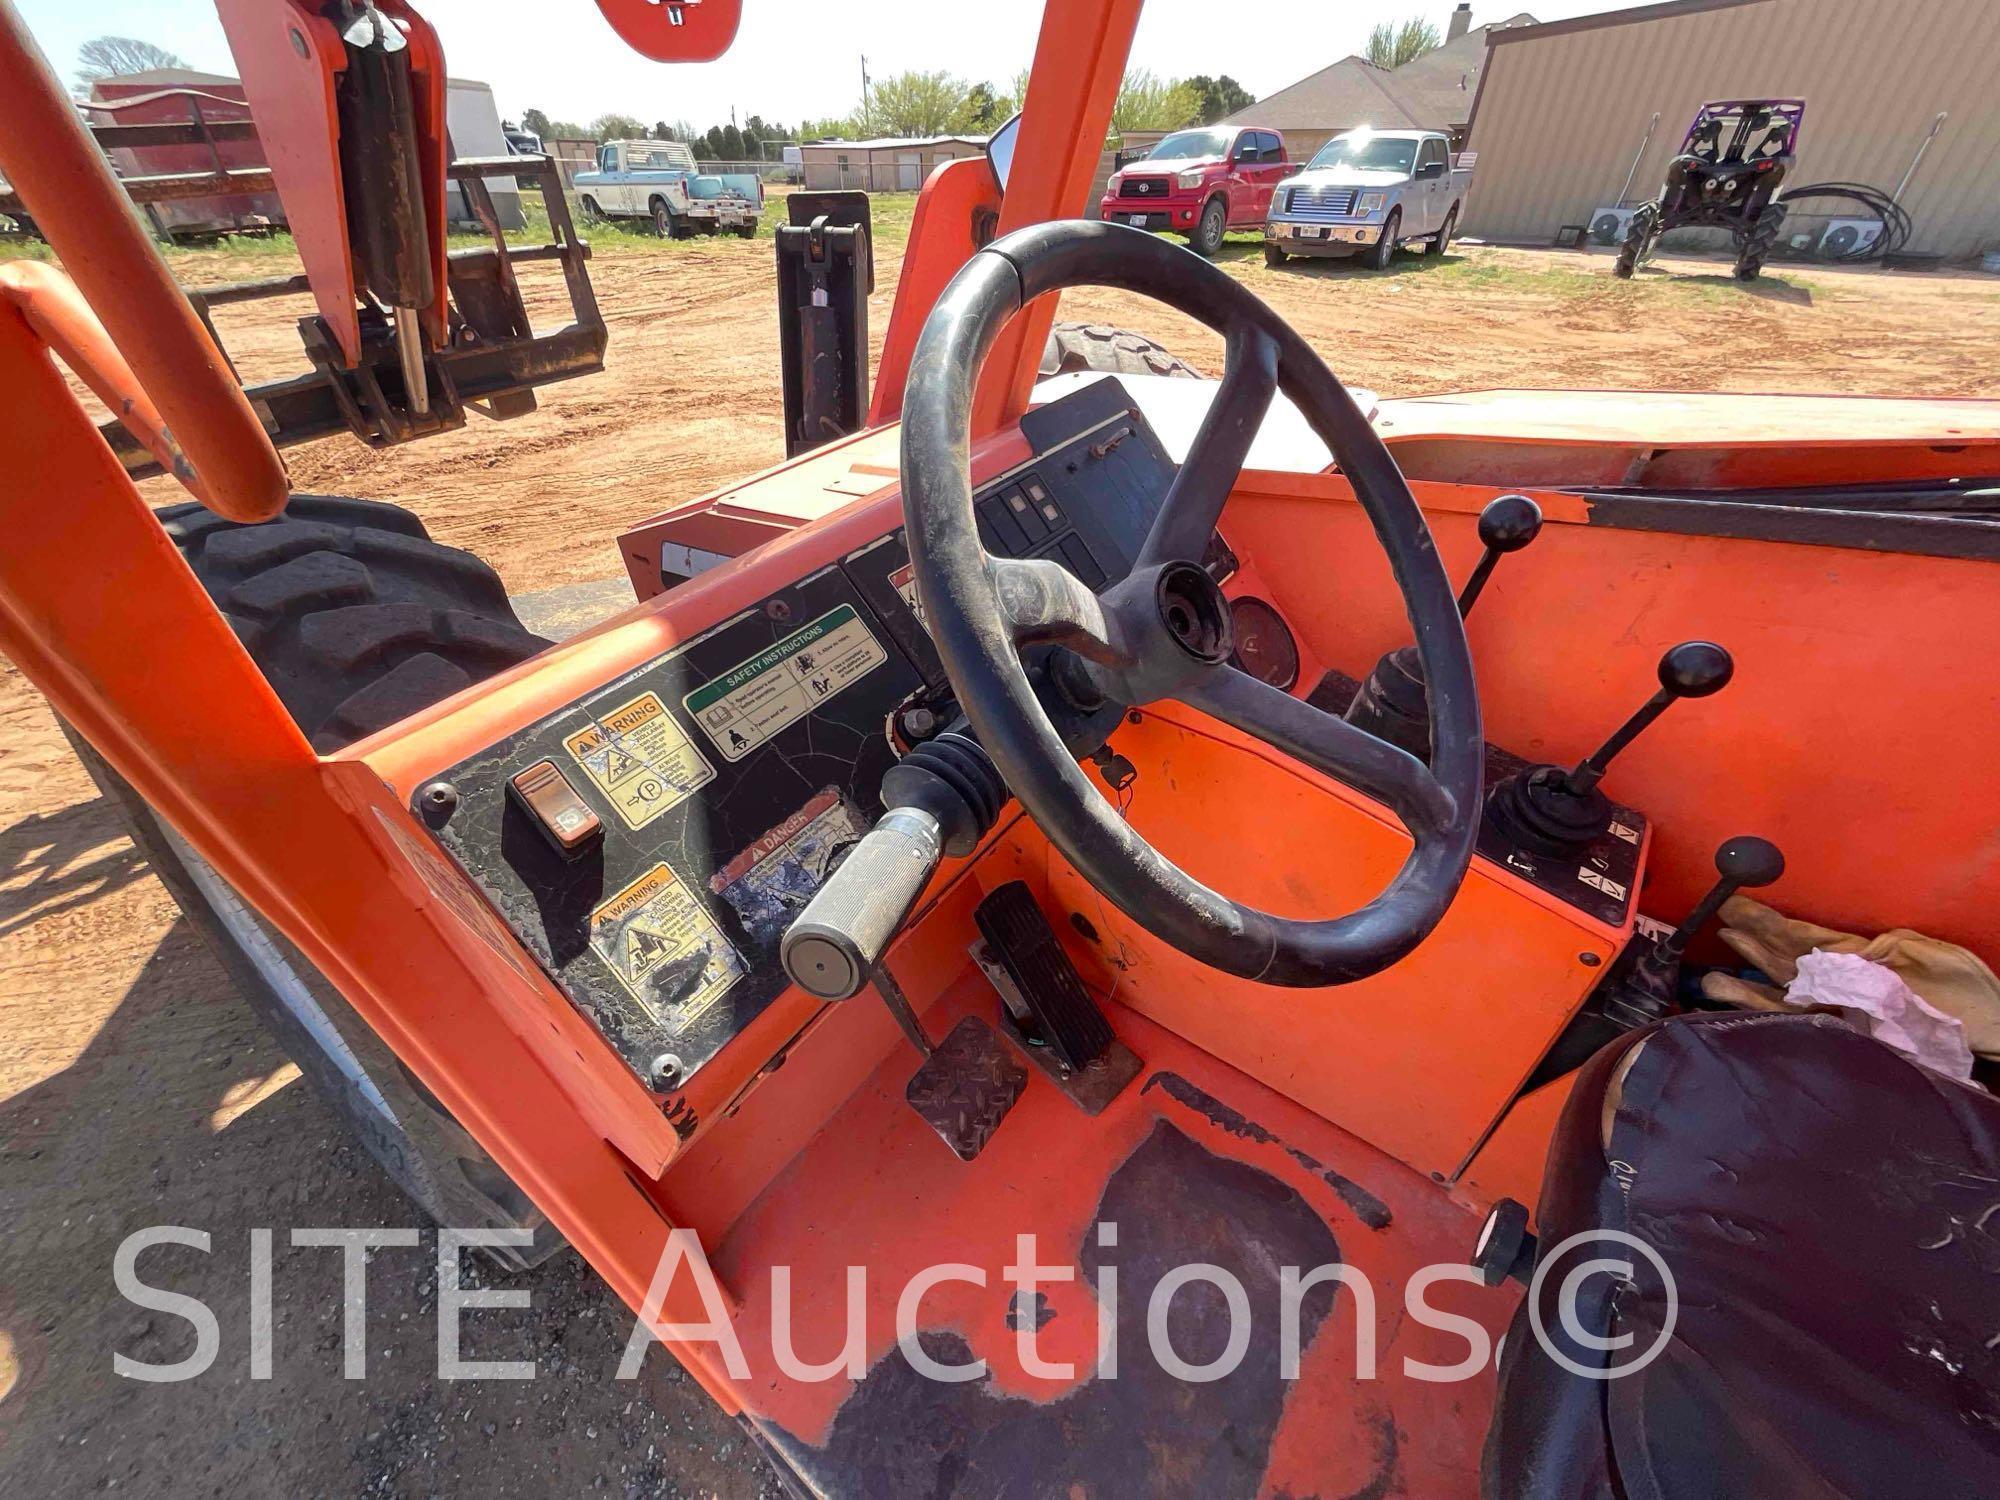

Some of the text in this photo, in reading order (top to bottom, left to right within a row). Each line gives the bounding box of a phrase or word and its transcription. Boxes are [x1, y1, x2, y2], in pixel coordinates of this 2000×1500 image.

[726, 624, 823, 687] SAFETY INSTRUCTIONS
[590, 700, 657, 746] WARNING
[632, 721, 656, 737] VEHICLE
[635, 721, 666, 742] ROLLAWAY
[762, 811, 809, 849] DANGER
[608, 877, 660, 918] WARNING
[658, 909, 681, 929] vehicle
[701, 992, 710, 1000] no
